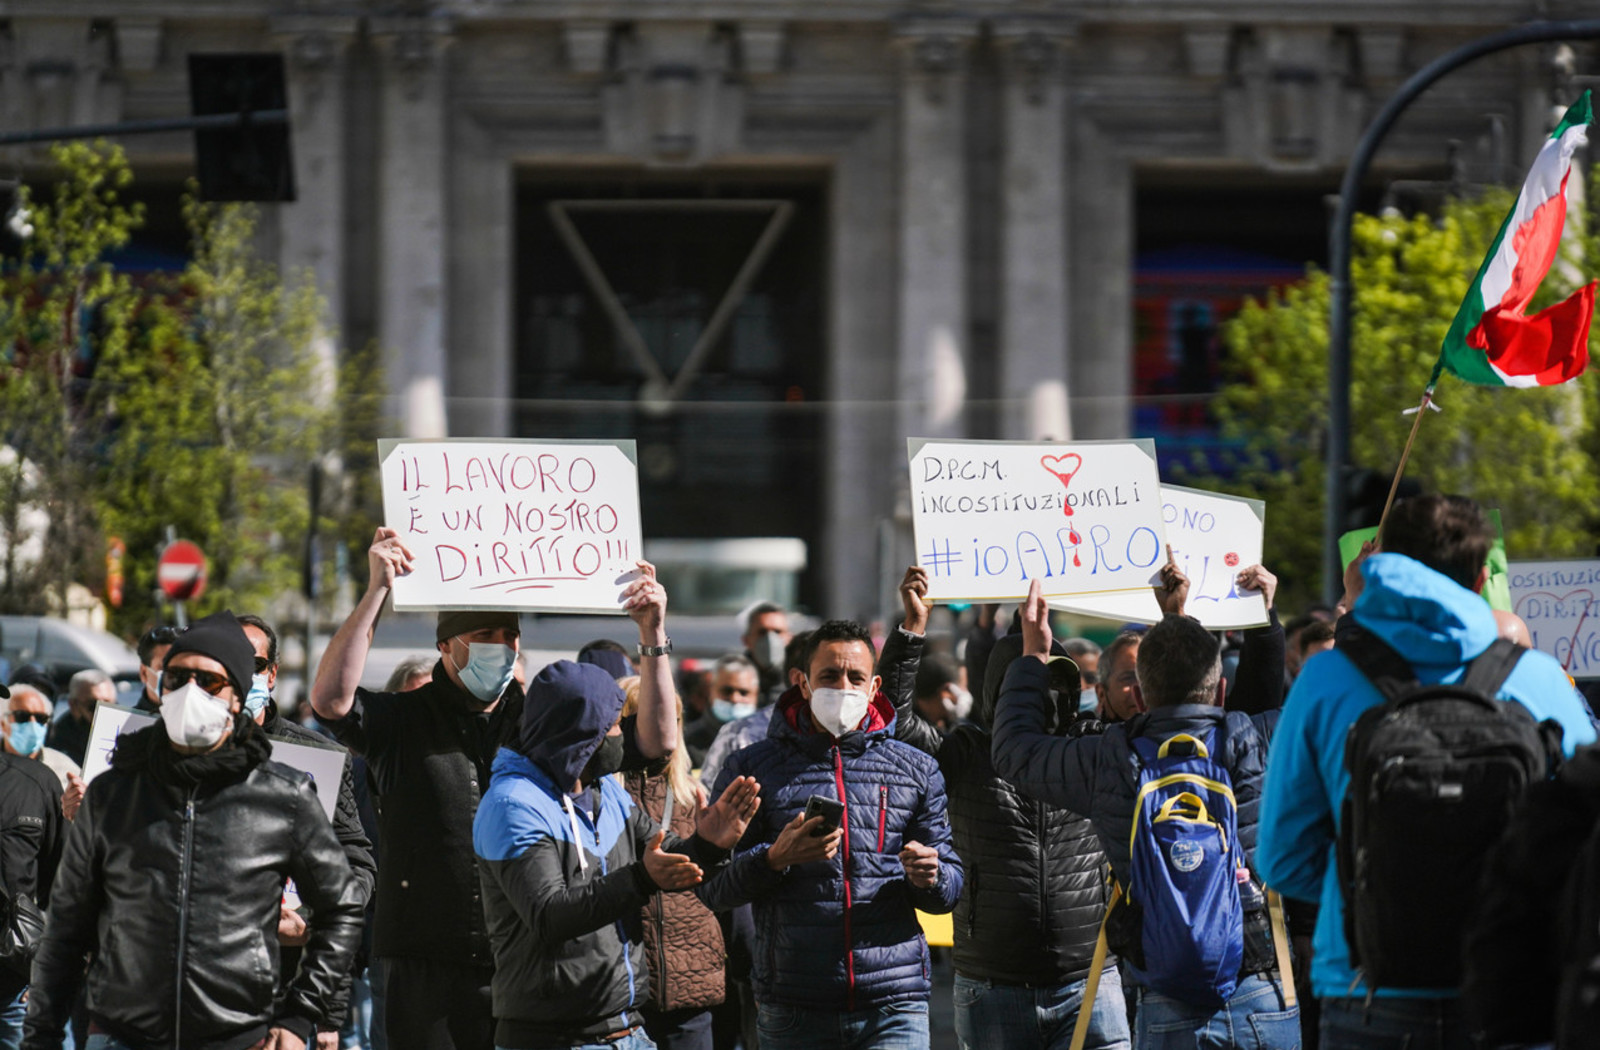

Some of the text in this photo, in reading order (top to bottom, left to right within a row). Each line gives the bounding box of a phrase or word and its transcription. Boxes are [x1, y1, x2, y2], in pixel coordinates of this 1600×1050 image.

[443, 452, 597, 494] LAVORO
[923, 456, 1008, 483] D.P.C.M.
[442, 504, 483, 532] UN
[502, 499, 619, 536] NOSTRO
